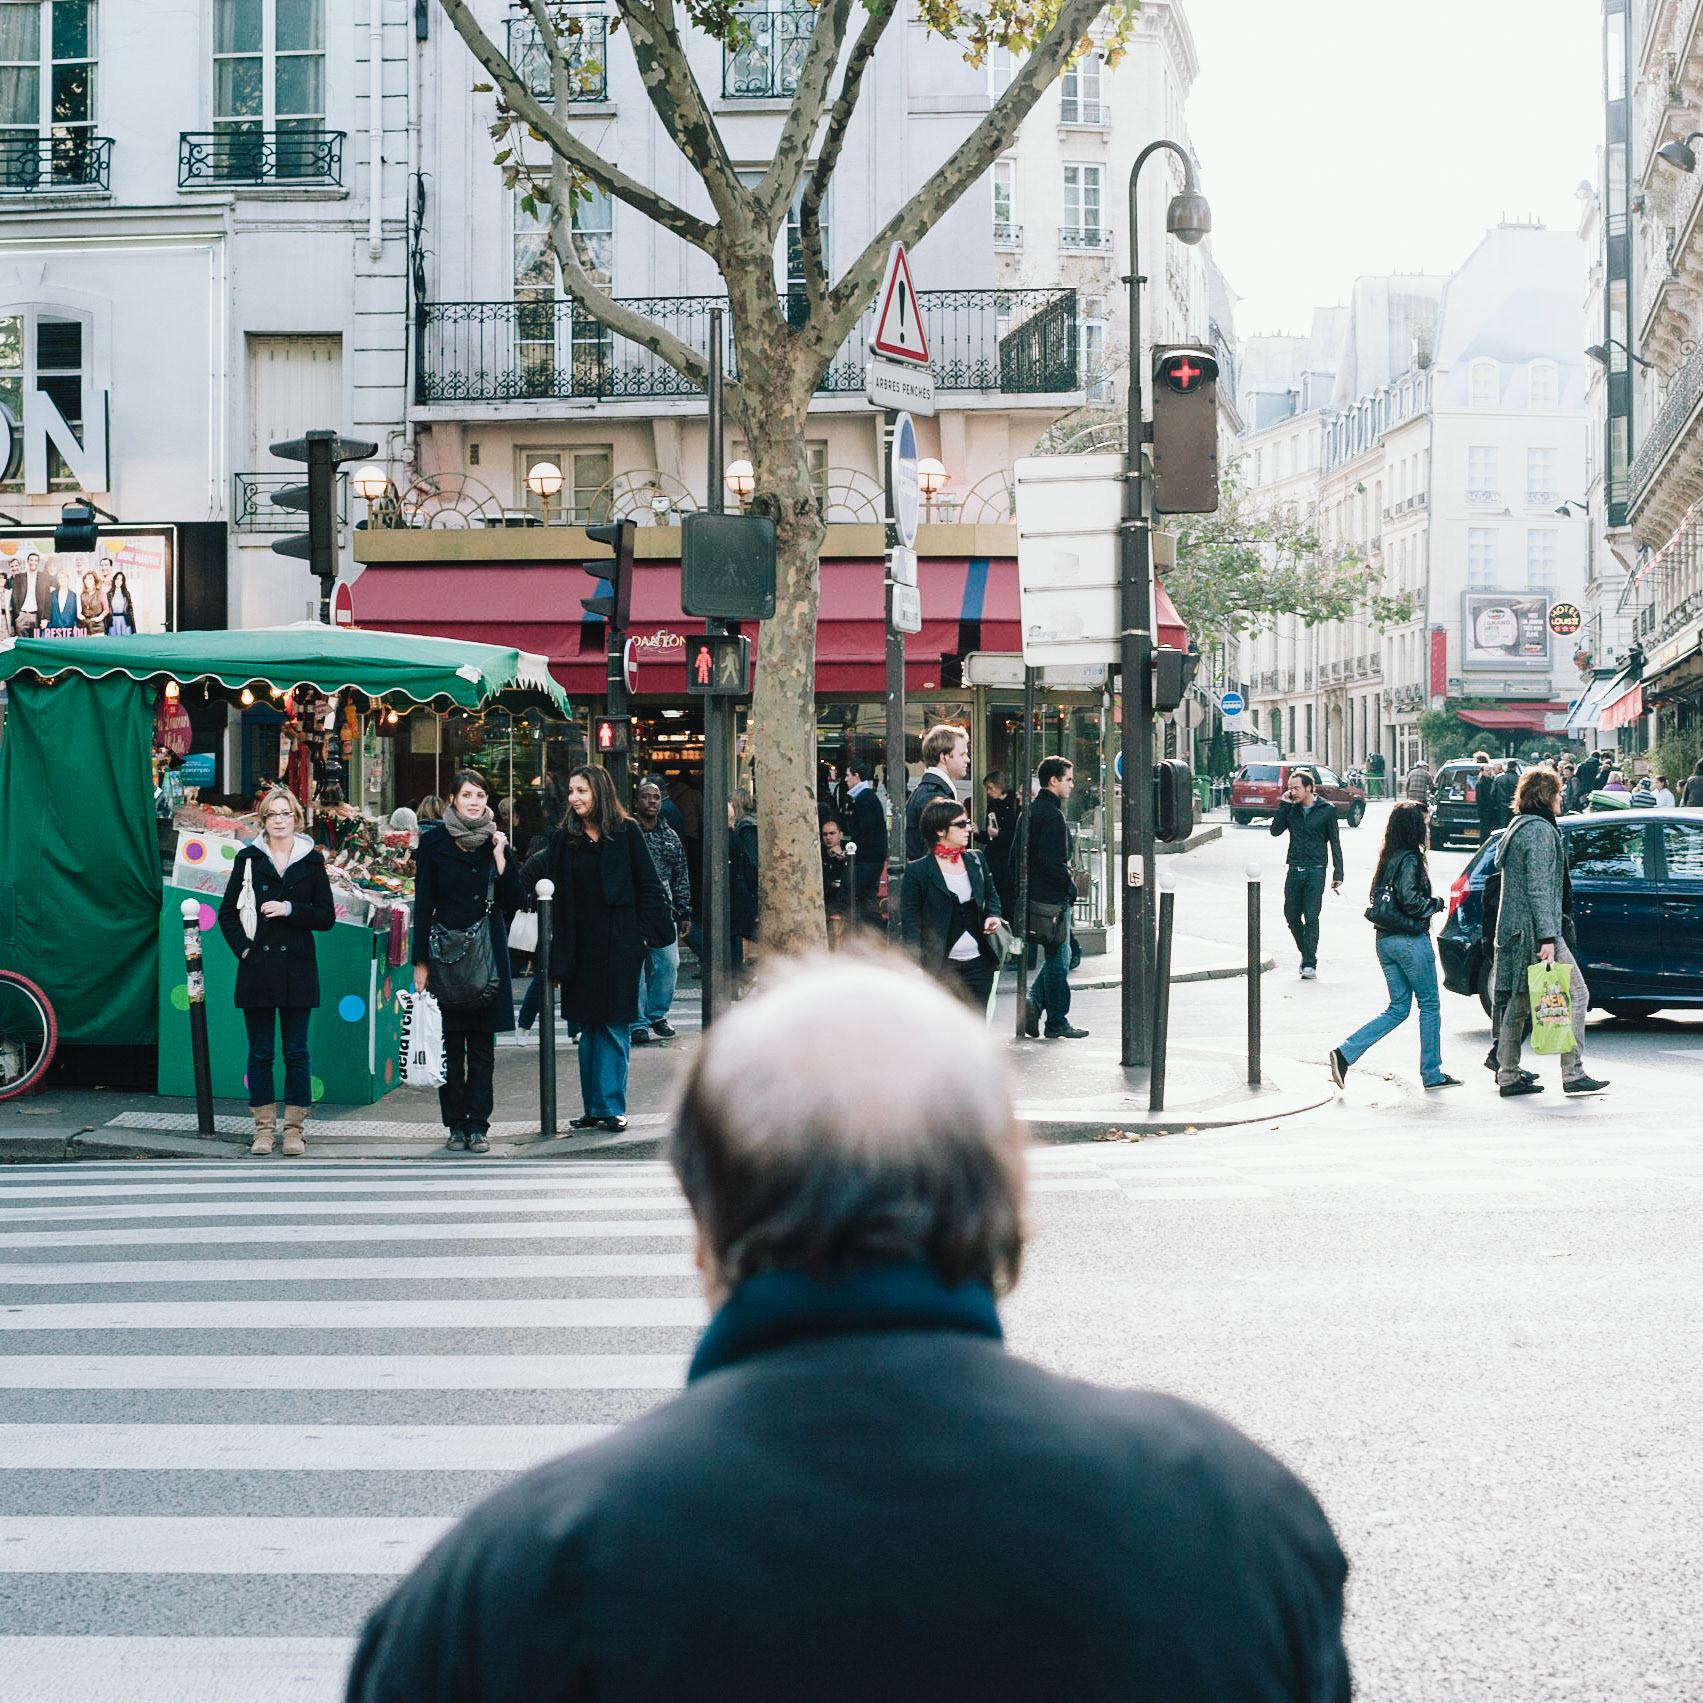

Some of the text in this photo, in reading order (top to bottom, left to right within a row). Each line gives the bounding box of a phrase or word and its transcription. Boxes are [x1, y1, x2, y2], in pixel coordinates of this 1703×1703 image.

[876, 377, 900, 392] ARBRES
[0, 389, 109, 495] N
[1550, 605, 1579, 618] HOTEL
[44, 627, 73, 638] RESTE
